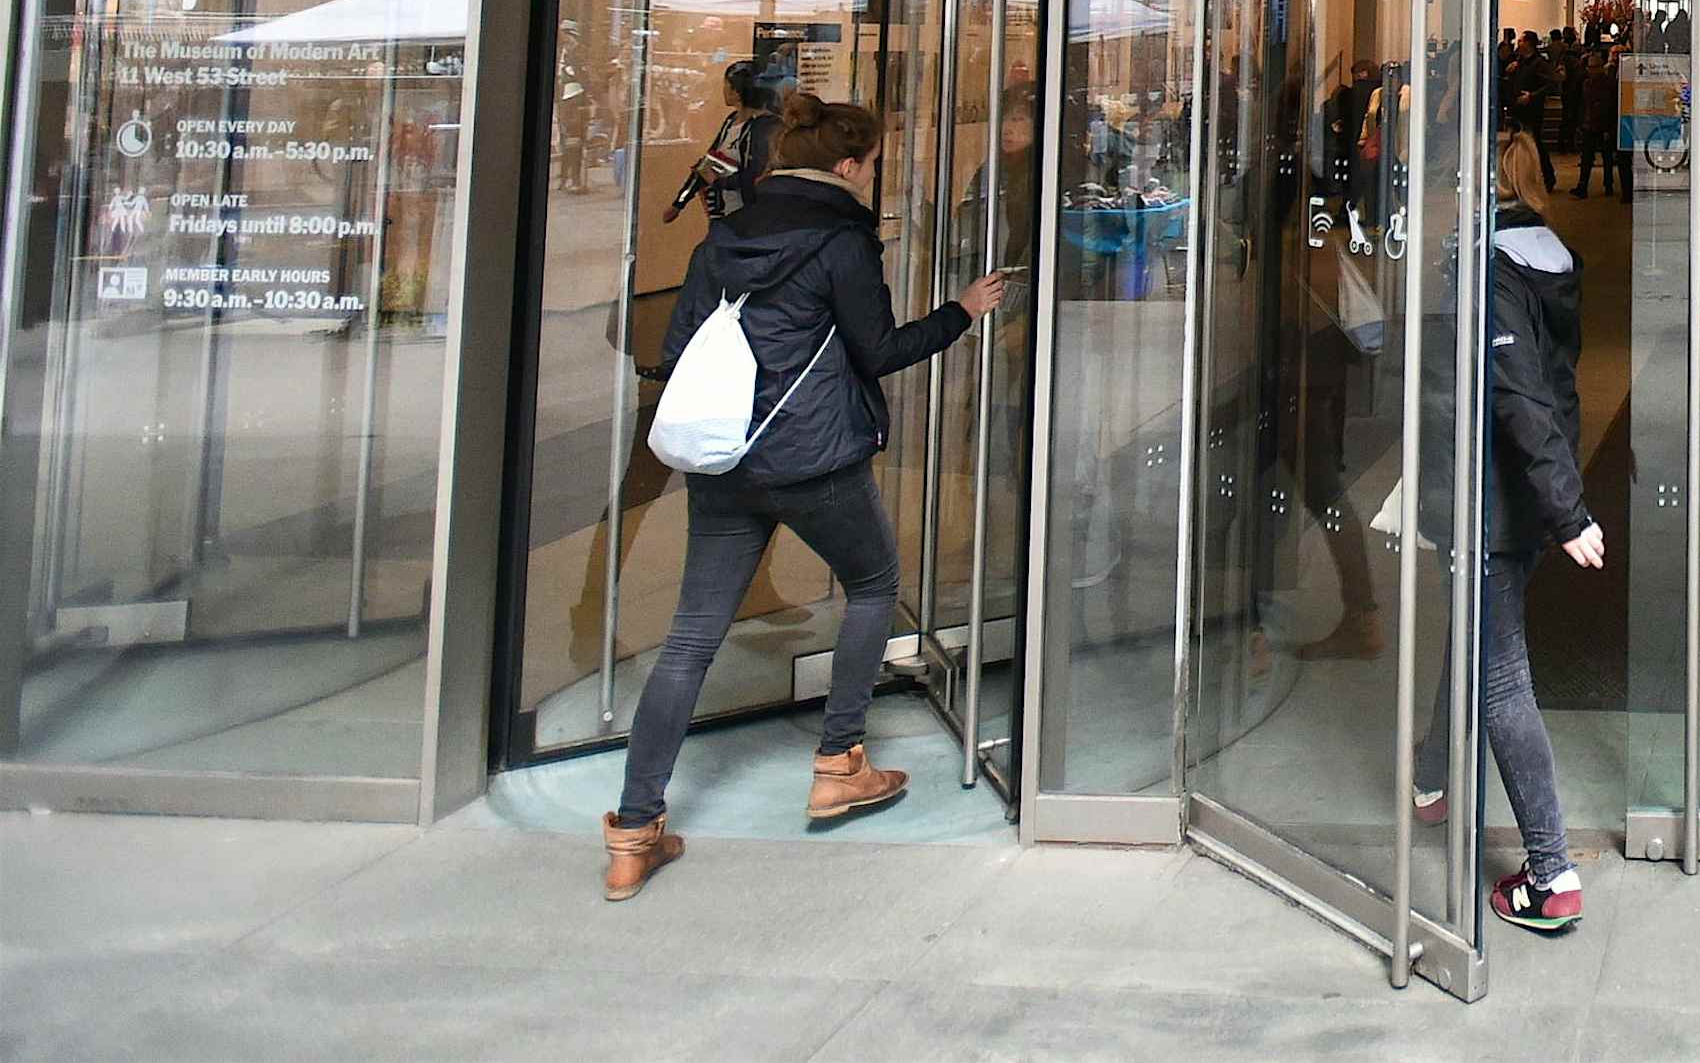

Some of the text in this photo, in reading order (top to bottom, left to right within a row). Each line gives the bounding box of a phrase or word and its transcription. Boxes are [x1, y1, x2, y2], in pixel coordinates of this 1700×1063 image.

[122, 42, 380, 61] The Museum of Modern Art
[121, 67, 289, 85] 11 West 53 Street
[177, 120, 295, 133] OPEN EVERY DAY
[176, 141, 230, 159] 10:30
[333, 146, 374, 163] p.m.
[171, 194, 248, 207] OPEN LATE
[169, 215, 237, 237] Fridays
[241, 216, 284, 235] until
[289, 216, 335, 235] 8:00
[166, 269, 330, 283] MEMBER EARLY HOURS
[163, 289, 209, 307] 9:30
[323, 297, 364, 310] a.m.
[1512, 884, 1531, 912] N
